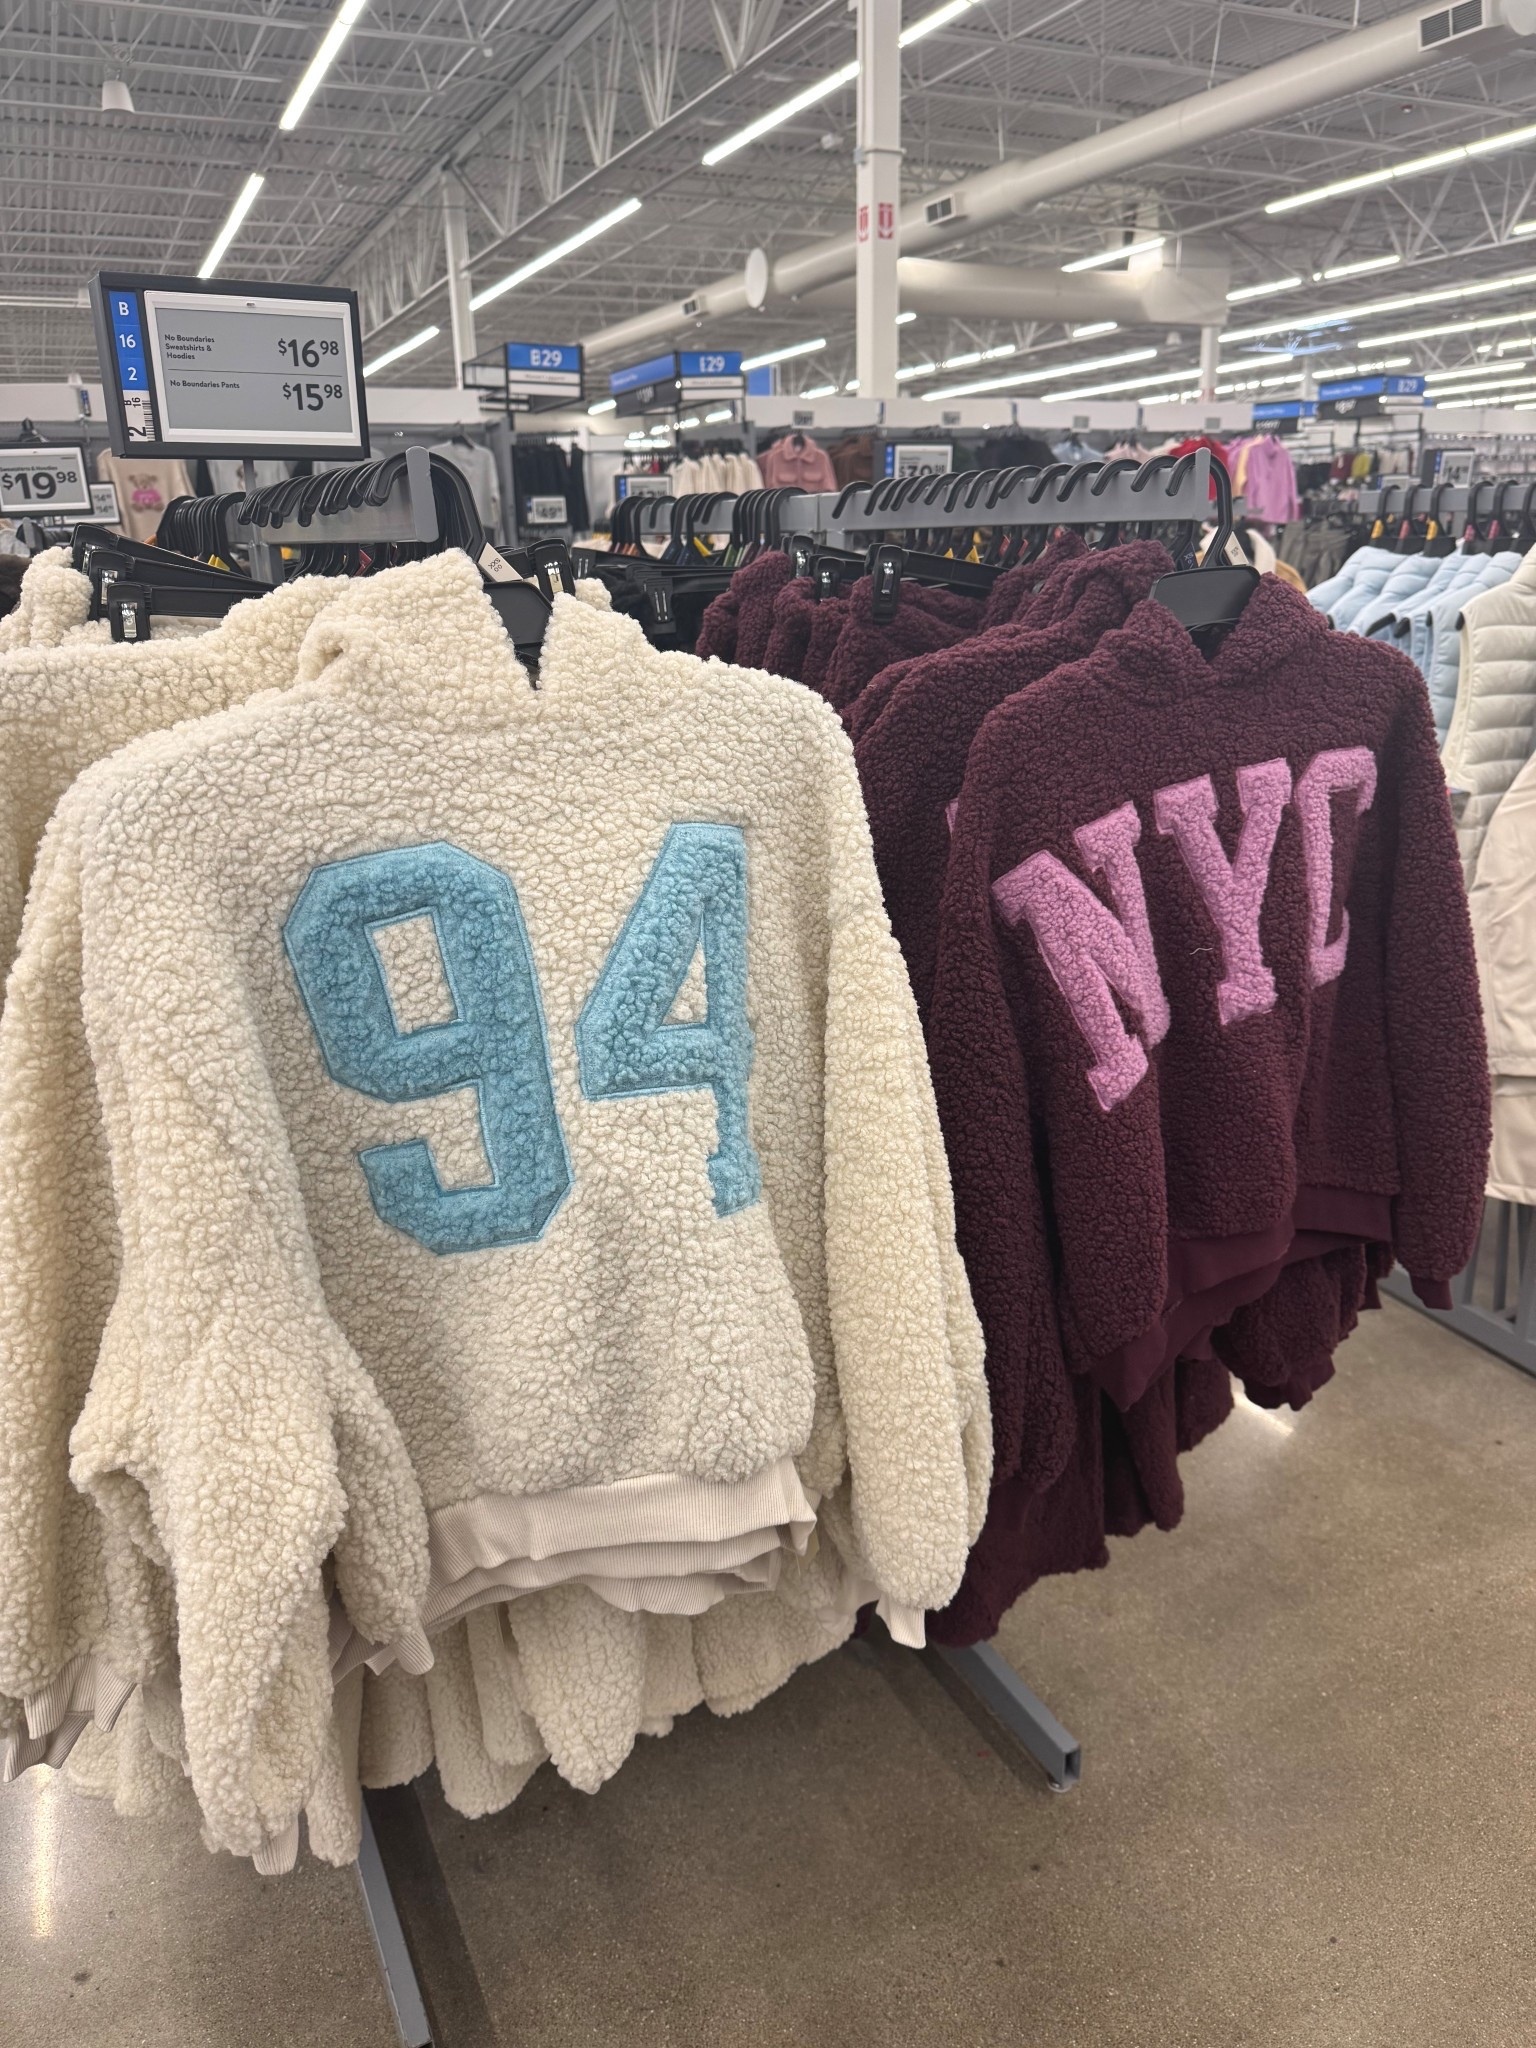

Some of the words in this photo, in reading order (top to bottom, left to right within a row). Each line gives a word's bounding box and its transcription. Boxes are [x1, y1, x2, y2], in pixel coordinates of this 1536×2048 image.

[118, 301, 130, 316] B
[119, 334, 137, 348] 16
[176, 334, 215, 343] Boundaries
[165, 343, 205, 352] Sweatshirts
[206, 344, 213, 352] &
[166, 352, 196, 360] Hoodies
[127, 367, 138, 381] 2
[170, 379, 181, 387] No
[181, 380, 220, 389] Boundaries
[221, 381, 241, 389] Pants
[132, 397, 141, 408] 16
[487, 557, 501, 570] XXS
[283, 820, 762, 1256] 94
